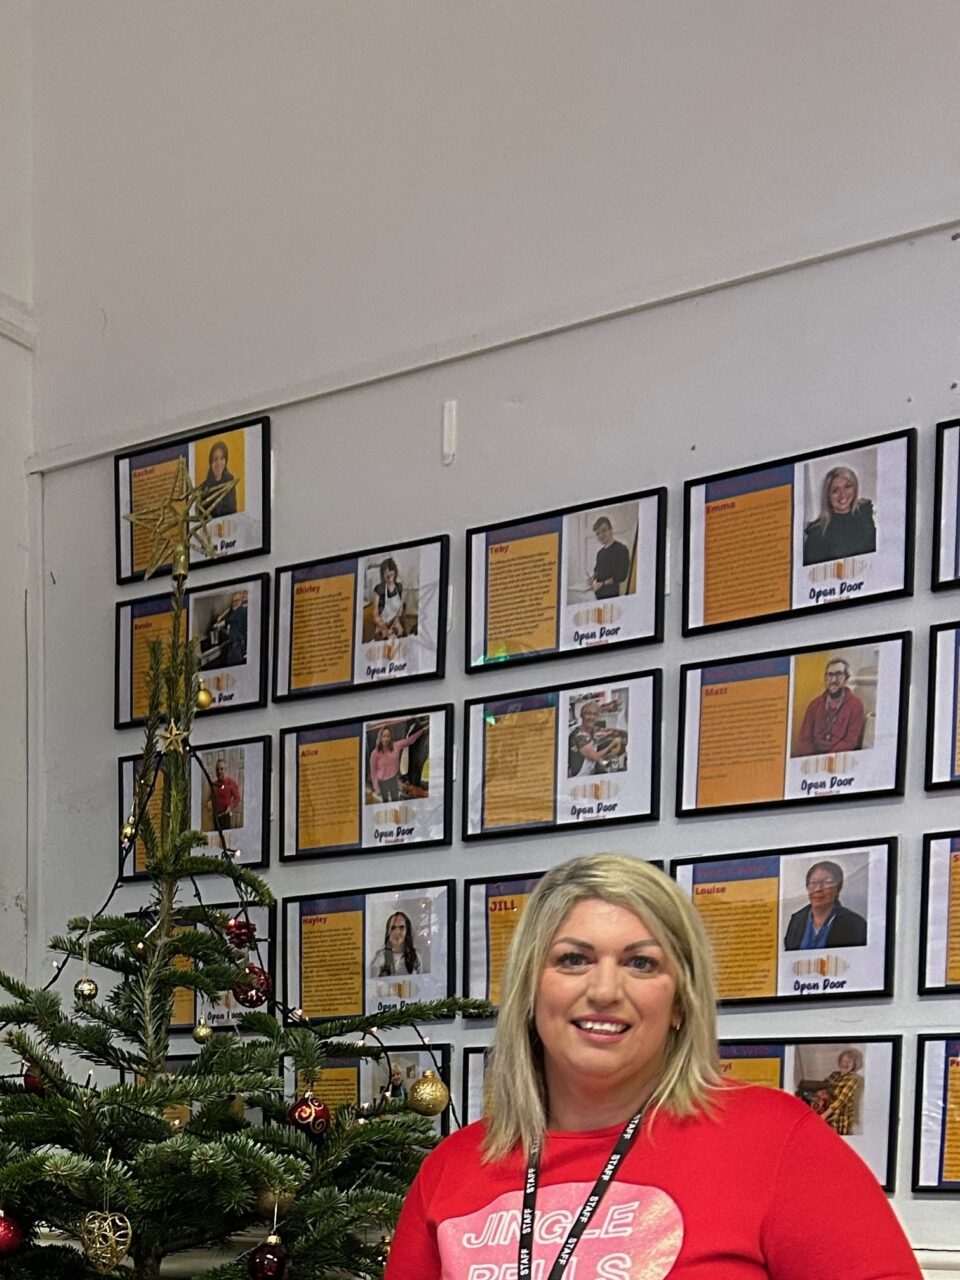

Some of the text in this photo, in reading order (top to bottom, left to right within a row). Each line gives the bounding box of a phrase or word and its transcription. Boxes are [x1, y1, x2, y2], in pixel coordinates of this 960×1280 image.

[706, 501, 736, 515] Emma
[220, 538, 237, 551] Door
[489, 543, 510, 555] Toby
[296, 584, 321, 596] Shirley
[809, 587, 836, 604] Open
[839, 581, 865, 596] Door
[573, 629, 597, 646] Open
[598, 625, 621, 640] Door
[366, 661, 407, 679] Open Door
[704, 686, 728, 698] Matt
[801, 779, 827, 796] Open
[829, 776, 855, 791] Door
[596, 802, 618, 814] Door
[396, 826, 415, 838] Door
[695, 885, 727, 896] Louise
[489, 899, 517, 912] JILL
[302, 915, 328, 926] Hayley
[793, 978, 847, 996] Open Door
[602, 1154, 621, 1181] STAFF
[526, 1168, 536, 1194] STAFF
[580, 1195, 600, 1223] STAFF
[463, 1201, 640, 1248] JINGLE
[522, 1208, 533, 1235] STAFF
[558, 1237, 578, 1266] STAFF
[520, 1248, 530, 1276] STAFF
